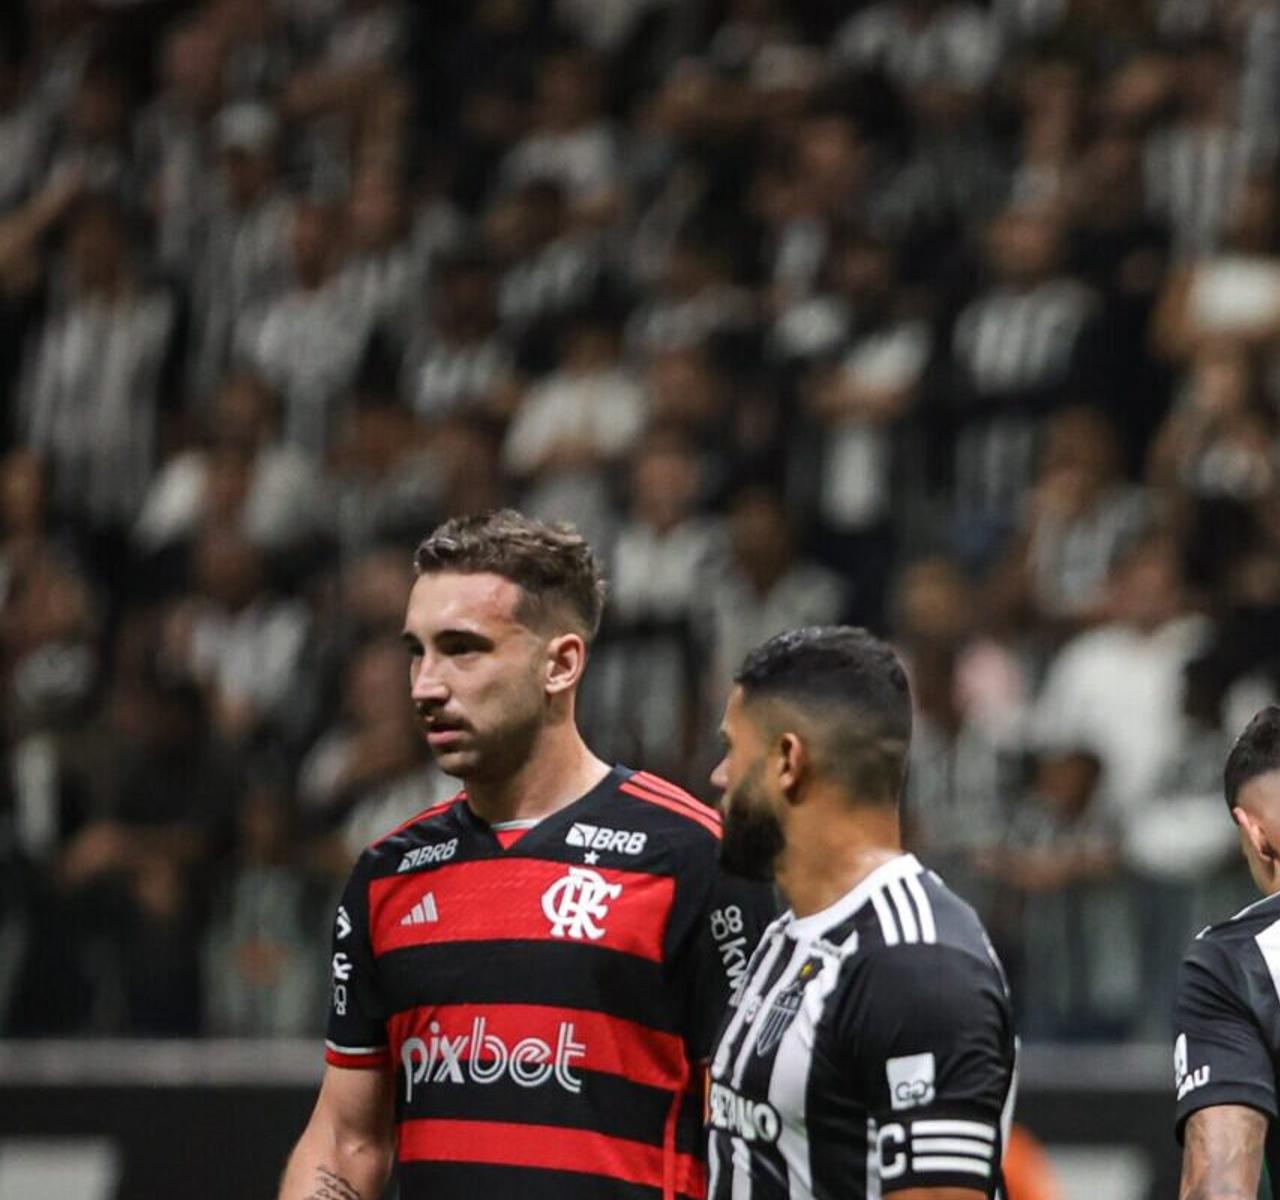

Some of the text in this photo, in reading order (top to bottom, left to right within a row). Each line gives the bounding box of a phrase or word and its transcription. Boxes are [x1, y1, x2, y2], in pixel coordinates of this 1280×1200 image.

[417, 838, 458, 866] BRB
[593, 829, 648, 855] BRB
[401, 1016, 586, 1103] pixbet
[877, 1123, 906, 1180] C
